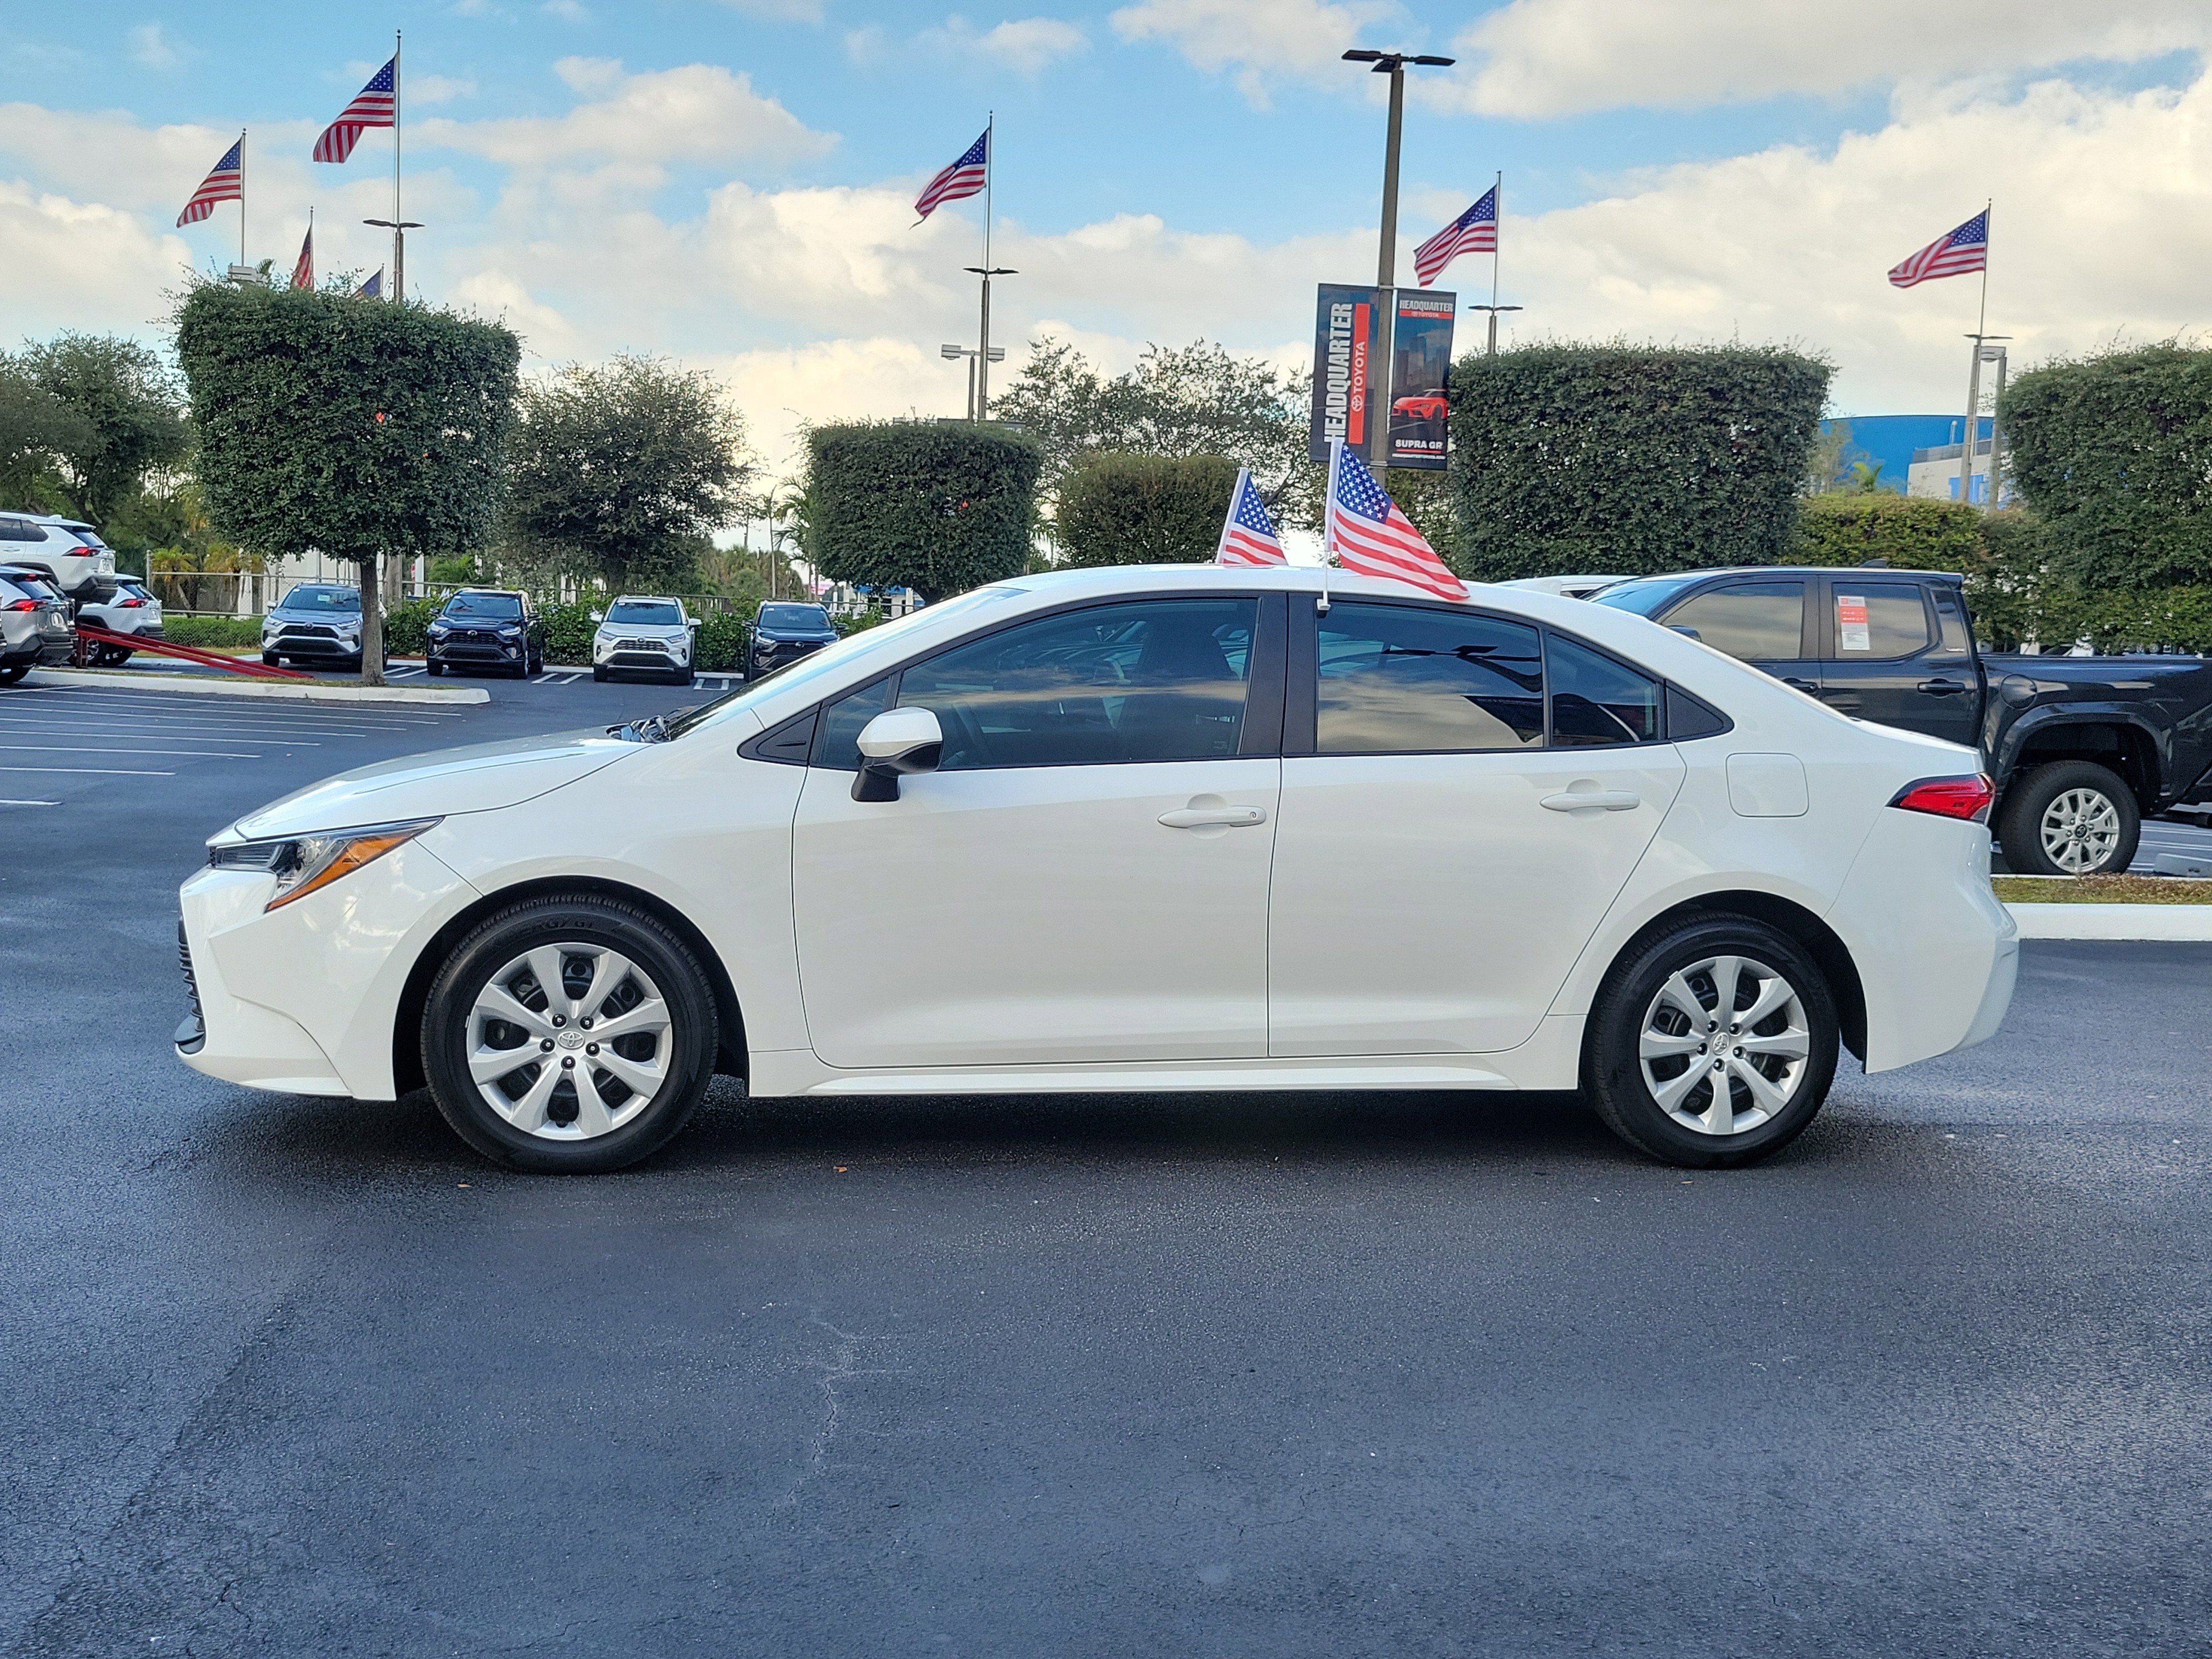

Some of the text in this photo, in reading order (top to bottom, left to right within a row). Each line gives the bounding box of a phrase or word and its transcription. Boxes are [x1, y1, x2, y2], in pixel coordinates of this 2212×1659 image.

[1400, 300, 1453, 312] HEADQUARTER
[1324, 303, 1352, 443] HEADQUARTER
[1353, 341, 1365, 394] TOYOTA
[1395, 439, 1443, 450] SUPRA GR
